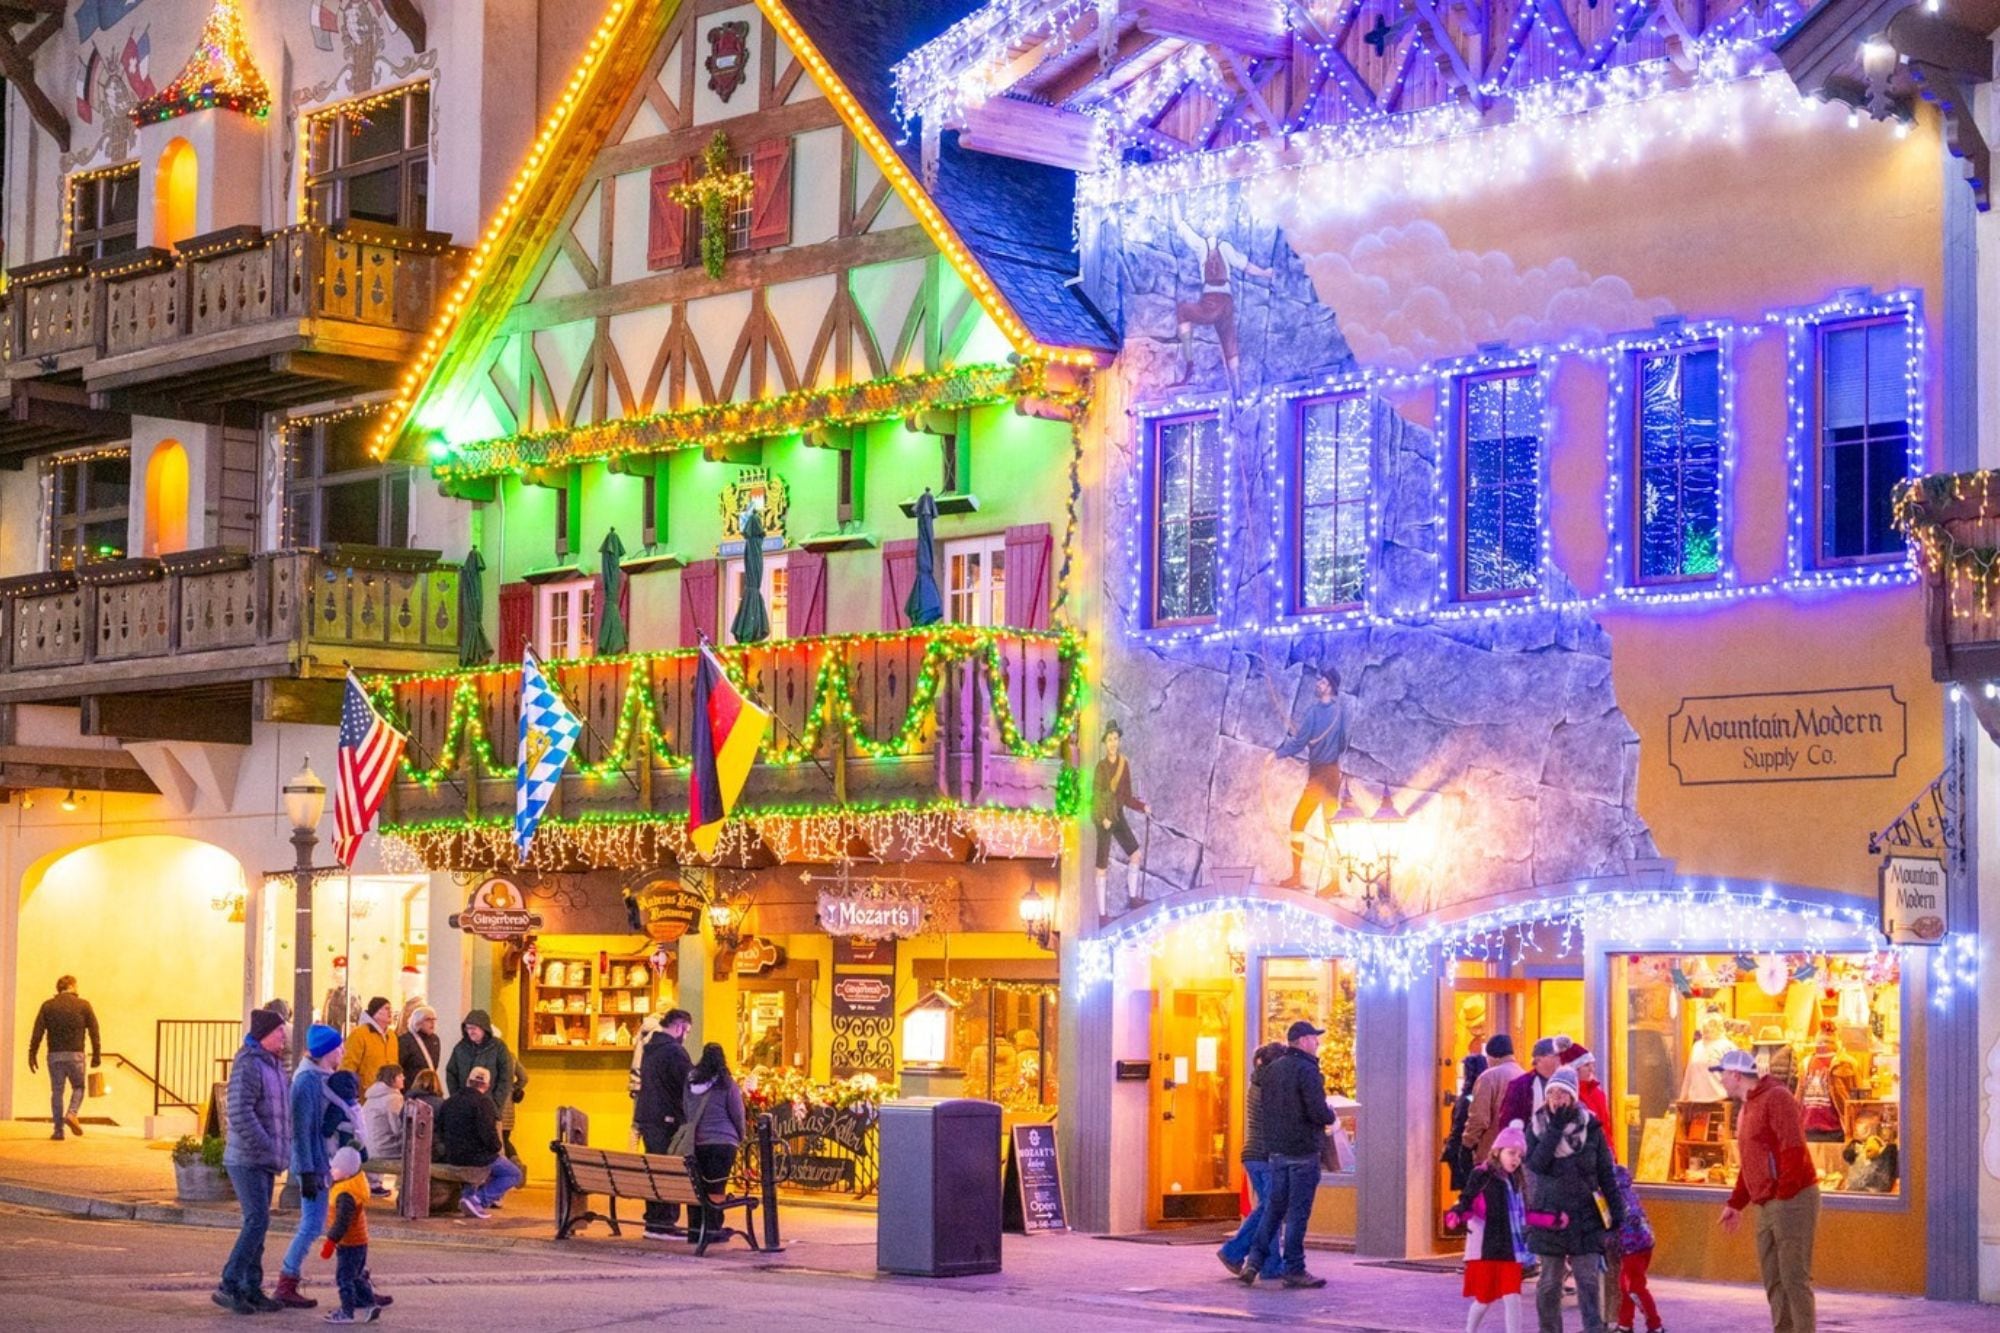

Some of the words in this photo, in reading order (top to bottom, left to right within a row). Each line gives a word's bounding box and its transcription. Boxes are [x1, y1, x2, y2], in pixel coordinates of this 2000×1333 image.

[1683, 713, 1792, 743] Mountain
[1792, 704, 1883, 738] Modern
[1743, 746, 1799, 772] Supply
[1807, 744, 1837, 765] Co.
[1890, 864, 1939, 886] Mountain
[1896, 887, 1936, 909] Modern
[473, 912, 530, 927] Gingerbread
[650, 906, 693, 921] Restaurant
[840, 902, 909, 928] Mozart's
[1030, 1200, 1057, 1213] Open
